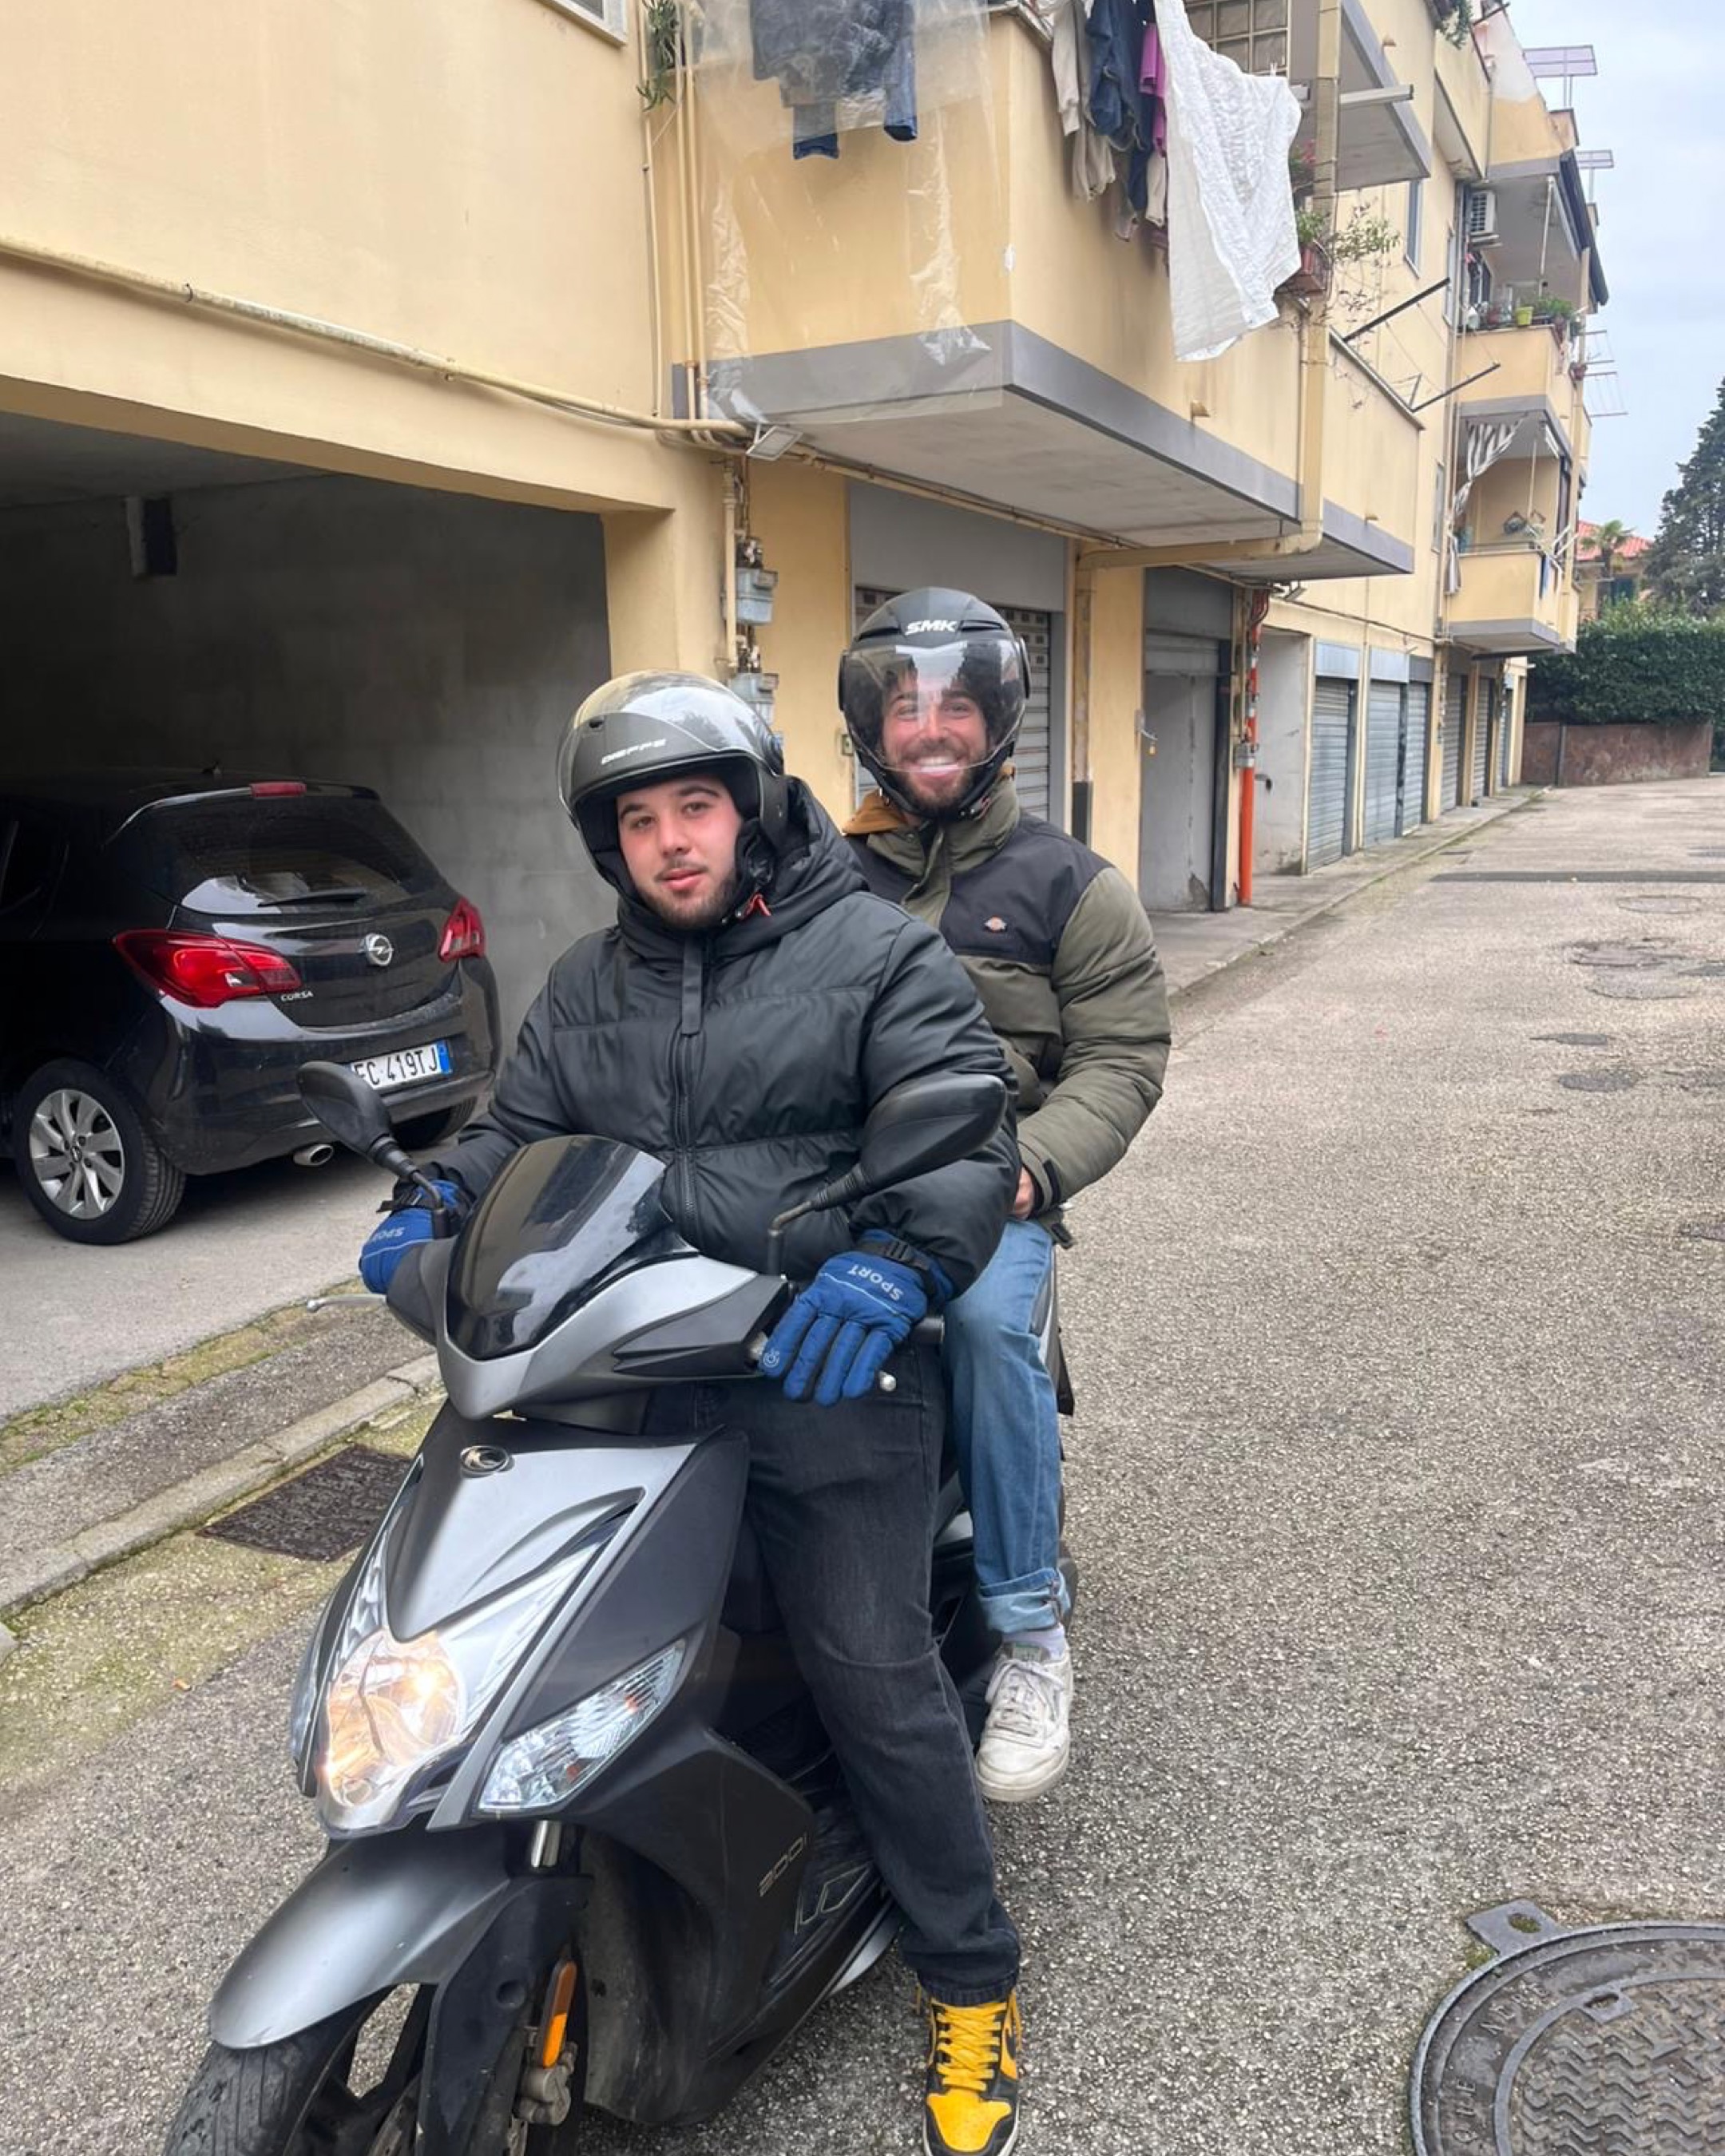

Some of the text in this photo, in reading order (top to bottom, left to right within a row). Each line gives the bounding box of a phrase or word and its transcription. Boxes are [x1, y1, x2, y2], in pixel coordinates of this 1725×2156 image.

[905, 620, 958, 635] SMK
[280, 990, 314, 1001] CORSA
[387, 1047, 438, 1080] 419TJ
[847, 1264, 904, 1301] SPORT
